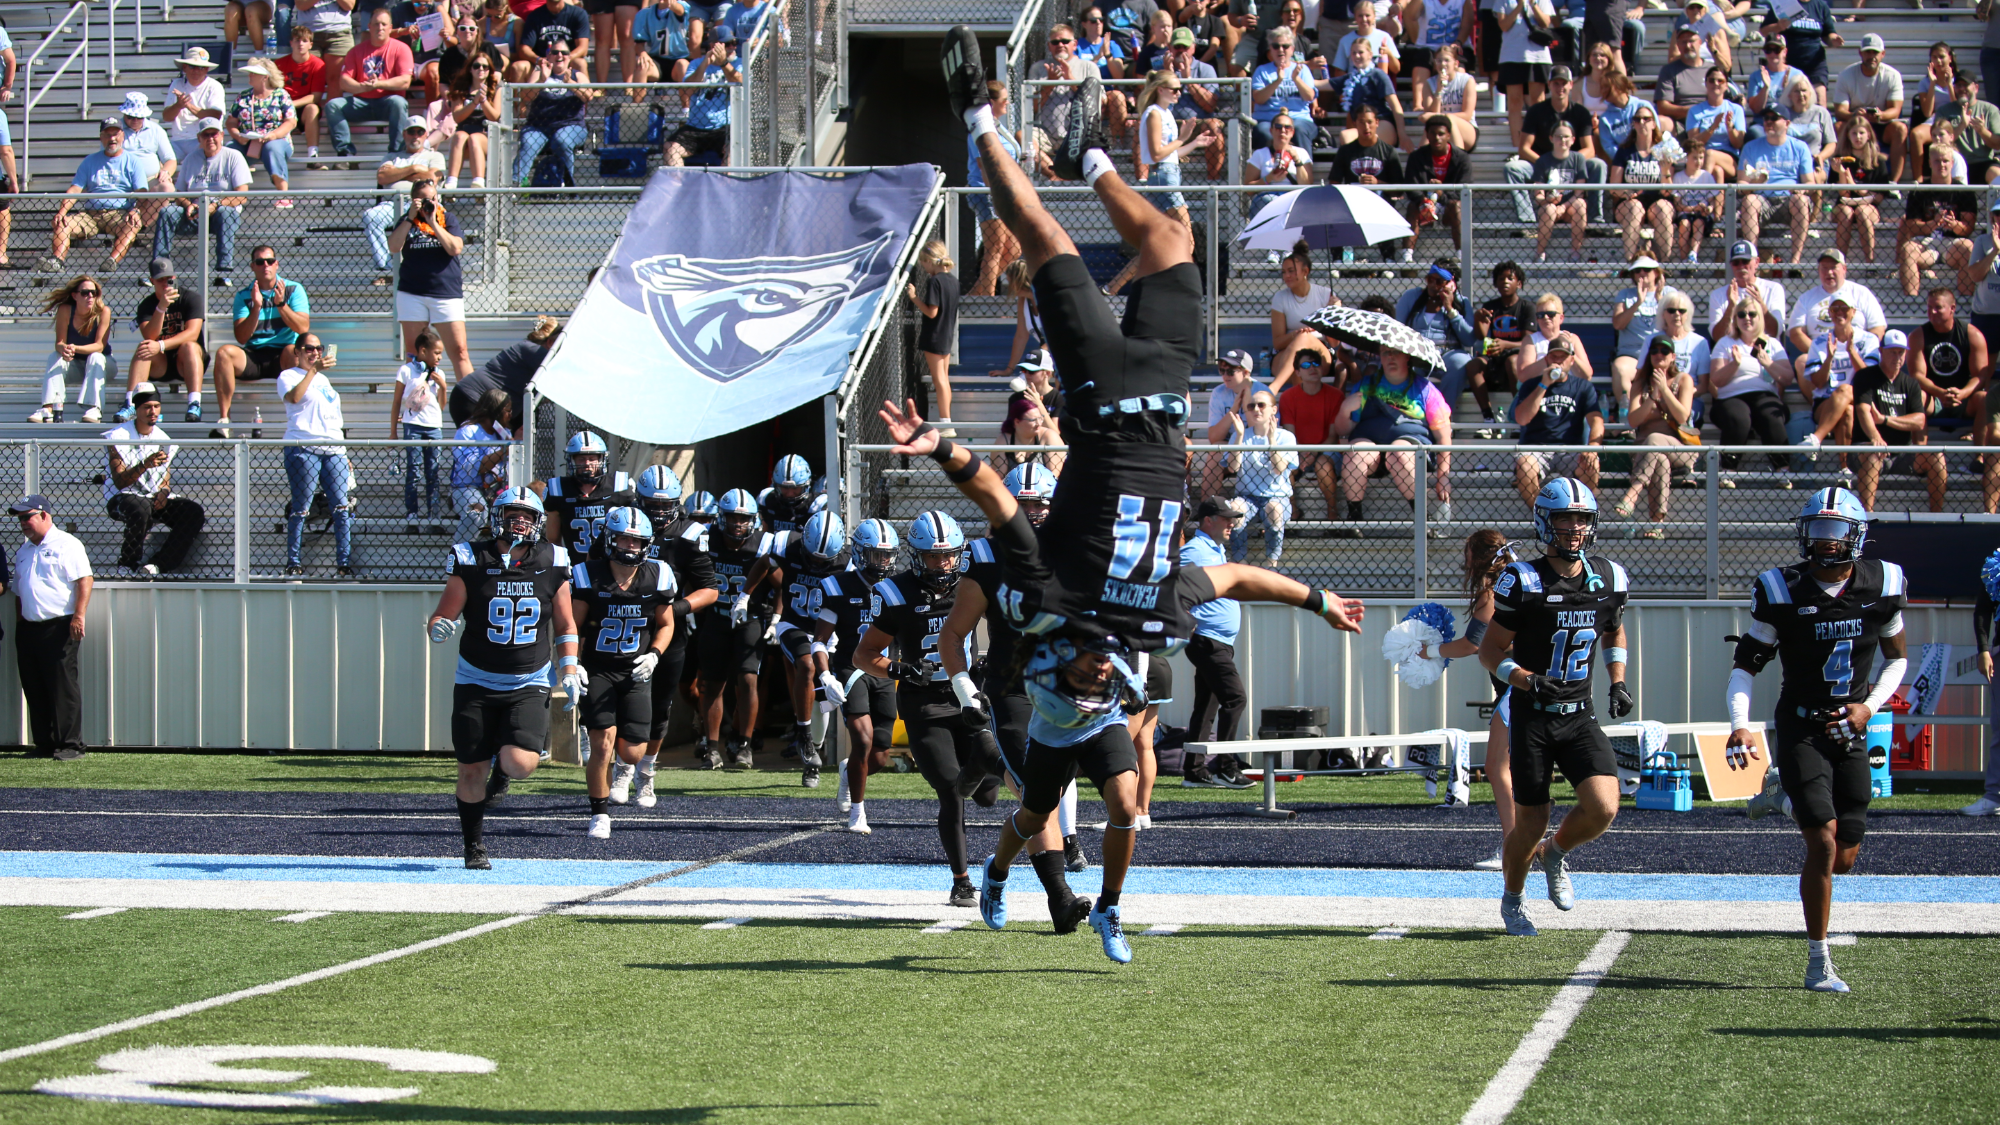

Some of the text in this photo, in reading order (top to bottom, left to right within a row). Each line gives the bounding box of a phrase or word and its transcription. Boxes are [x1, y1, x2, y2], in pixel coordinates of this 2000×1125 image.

[657, 30, 669, 56] 7
[1068, 99, 1085, 159] ADIZERO
[574, 505, 605, 517] PEACOCKS
[1107, 494, 1181, 583] 14
[715, 562, 743, 575] PEACOCKS
[497, 581, 534, 596] PEACOCKS
[1101, 578, 1160, 610] PEACOCKS
[1493, 571, 1516, 598] 12
[487, 596, 541, 645] 92
[608, 604, 642, 617] PEACOCKS
[1557, 610, 1597, 627] PEACOCKS
[595, 617, 648, 654] 25
[1814, 618, 1862, 640] PEACOCKS
[1546, 628, 1597, 681] 12
[1822, 639, 1854, 697] 4
[1869, 755, 1887, 764] NCAA
